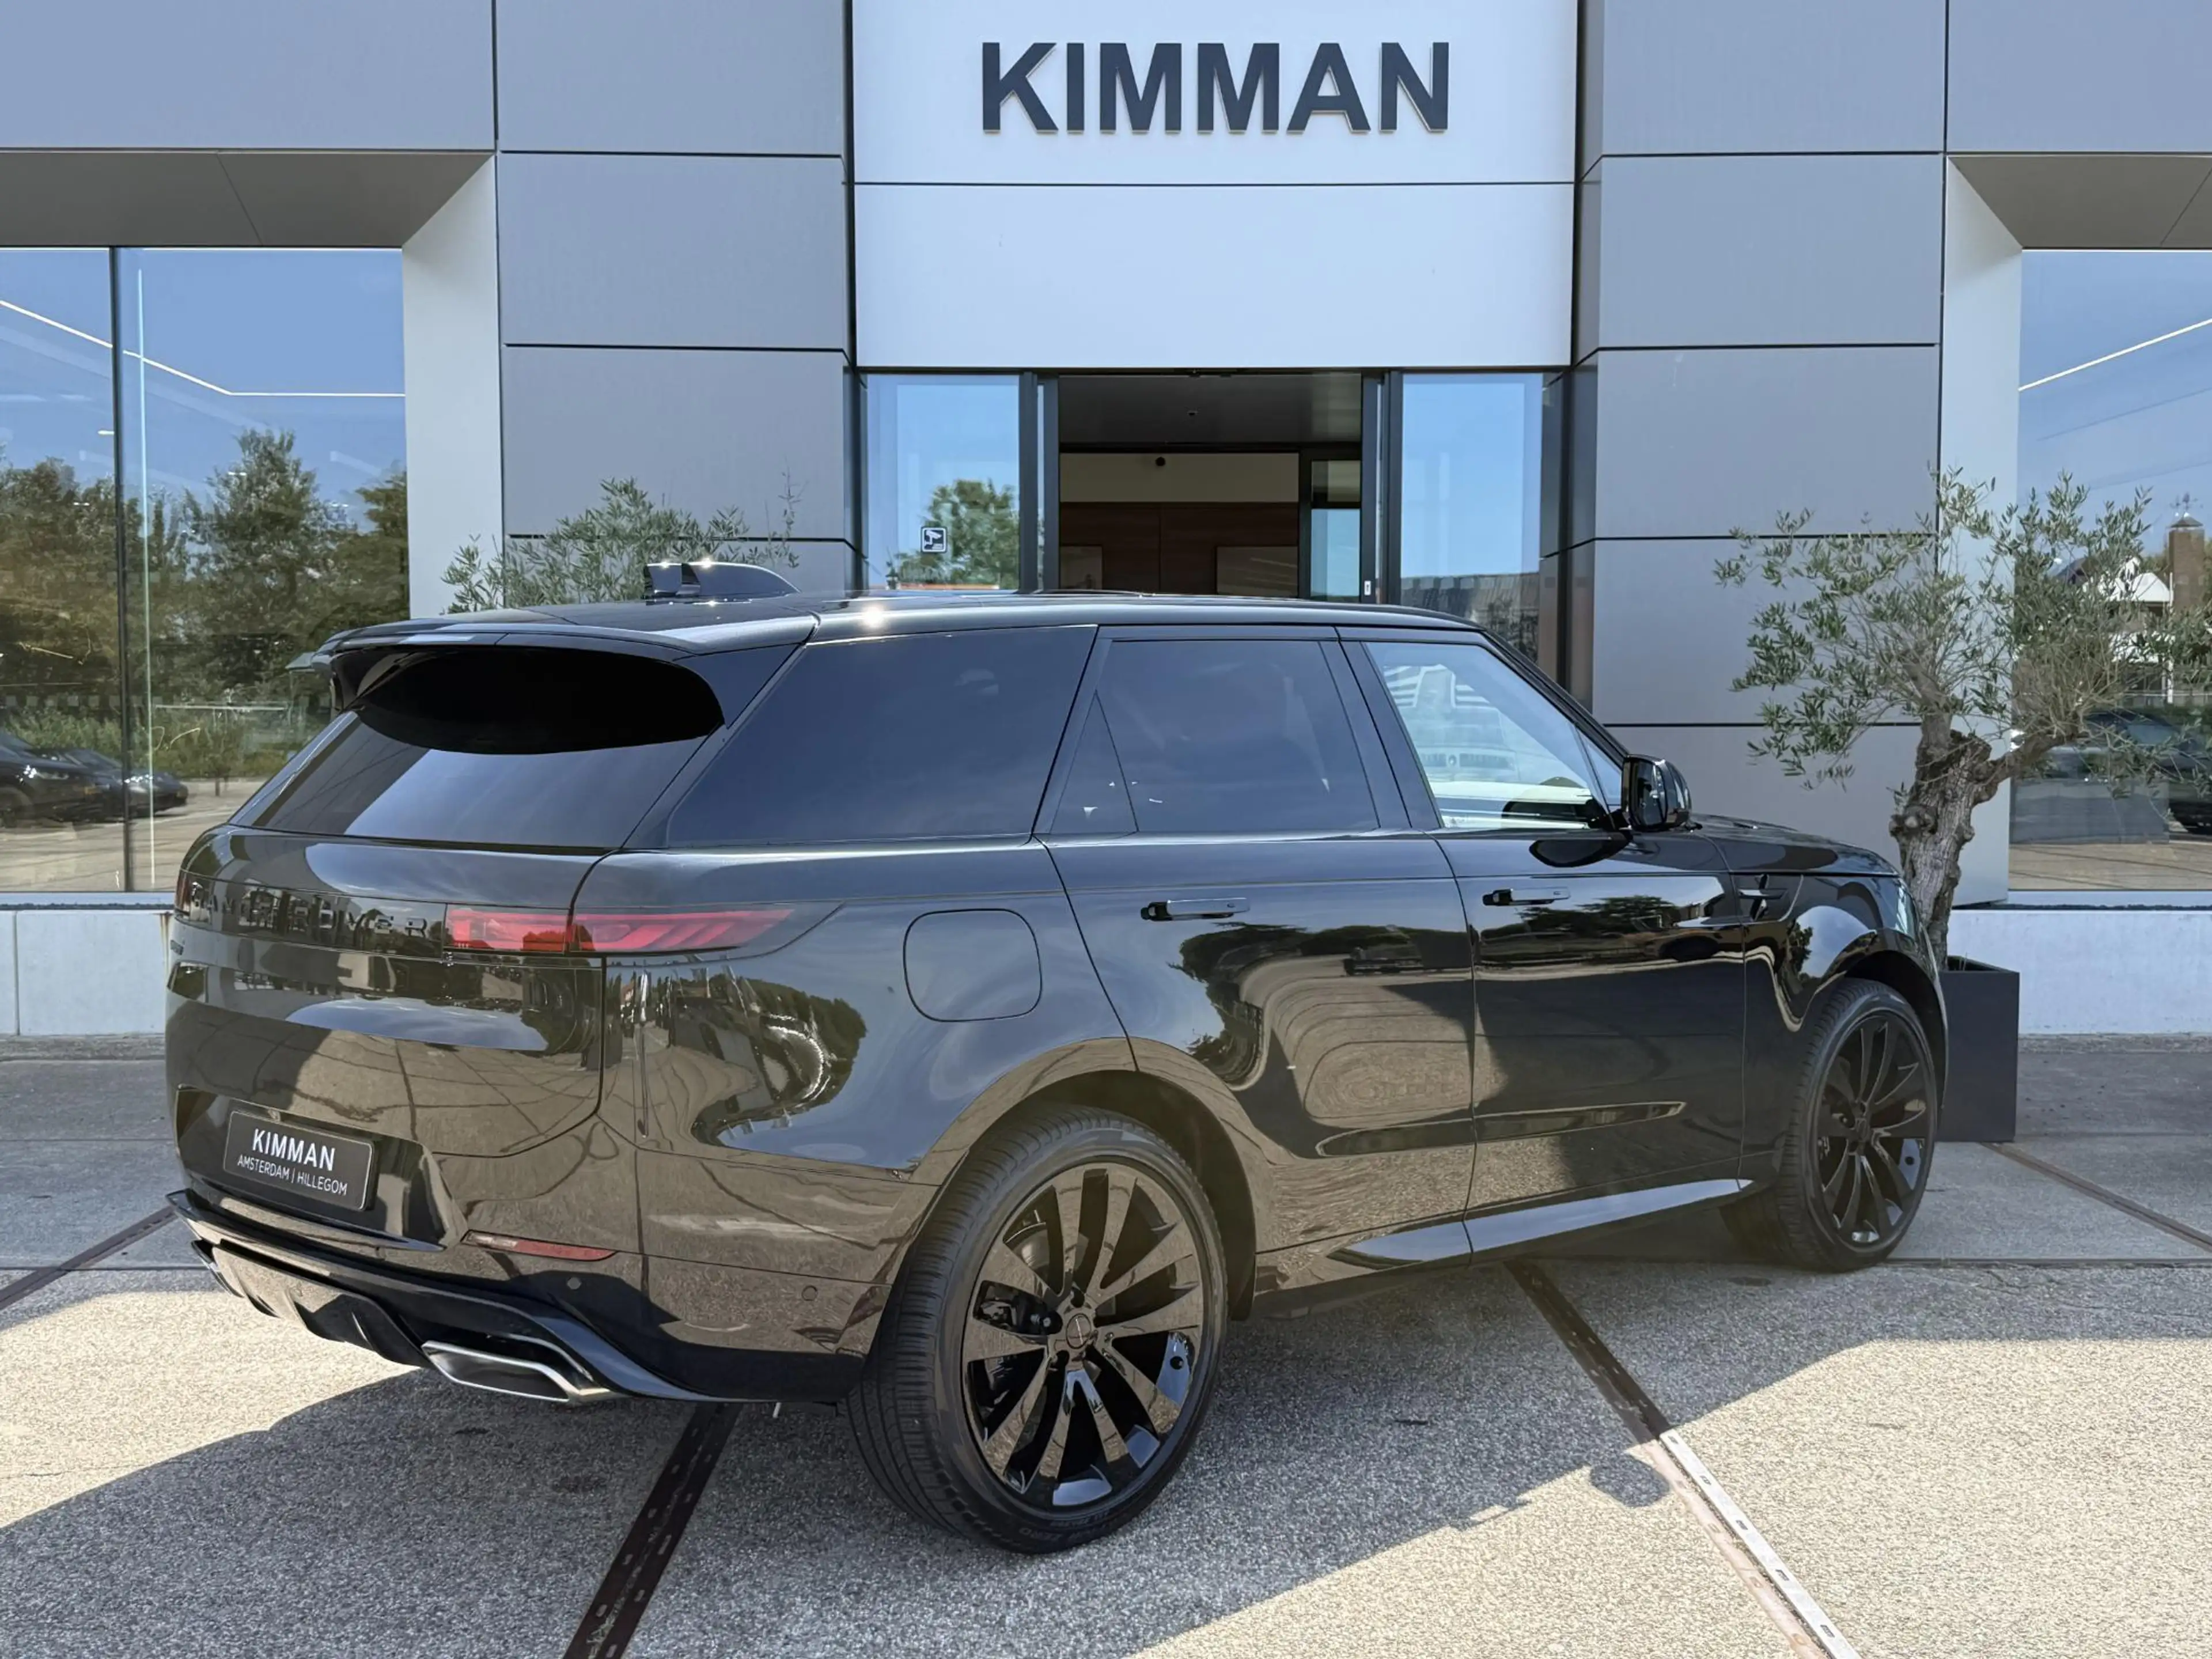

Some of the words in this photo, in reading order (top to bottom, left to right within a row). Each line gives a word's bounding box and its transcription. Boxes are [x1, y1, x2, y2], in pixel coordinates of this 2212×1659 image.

[982, 41, 1449, 133] KIMMAN
[252, 1128, 336, 1171] KIMMAN
[237, 1154, 290, 1180] AMSTERDAM
[297, 1170, 349, 1196] HILLEGOM
